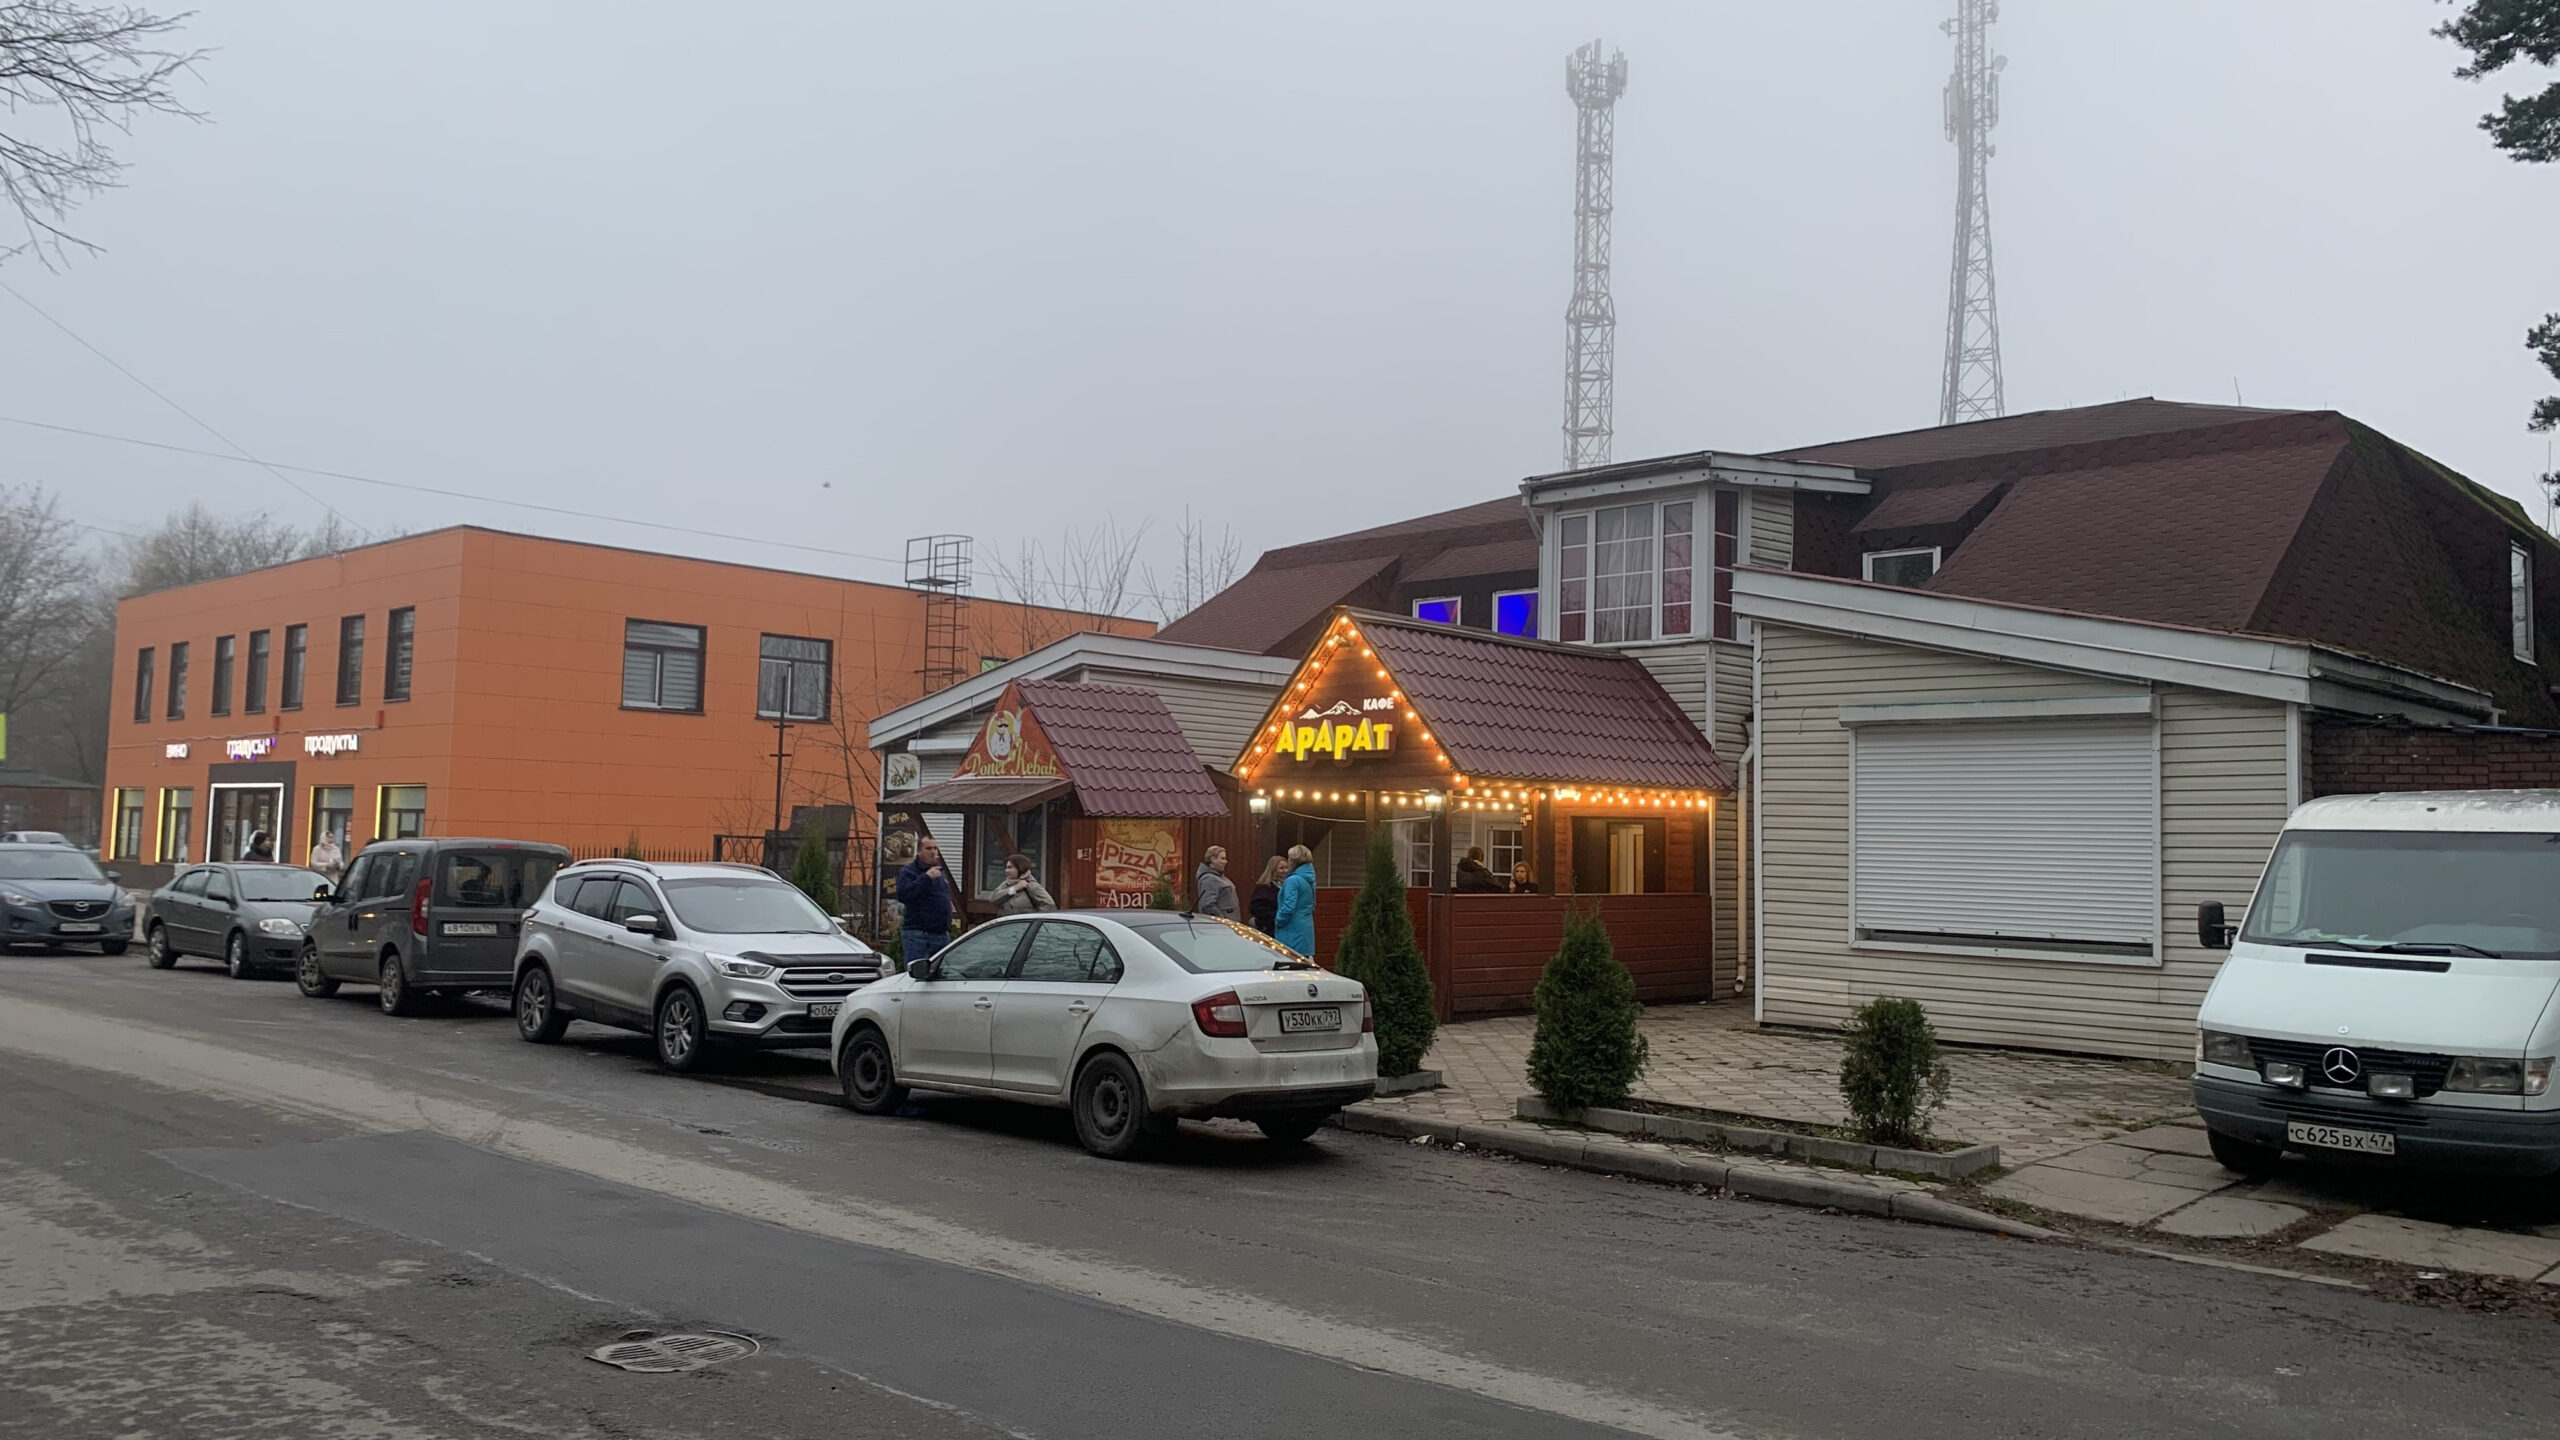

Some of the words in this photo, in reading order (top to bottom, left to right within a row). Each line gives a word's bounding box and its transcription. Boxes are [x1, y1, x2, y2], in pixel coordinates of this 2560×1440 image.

[1363, 697, 1394, 710] КАФЕ
[305, 735, 358, 756] продукты
[1011, 737, 1056, 775] Kebab
